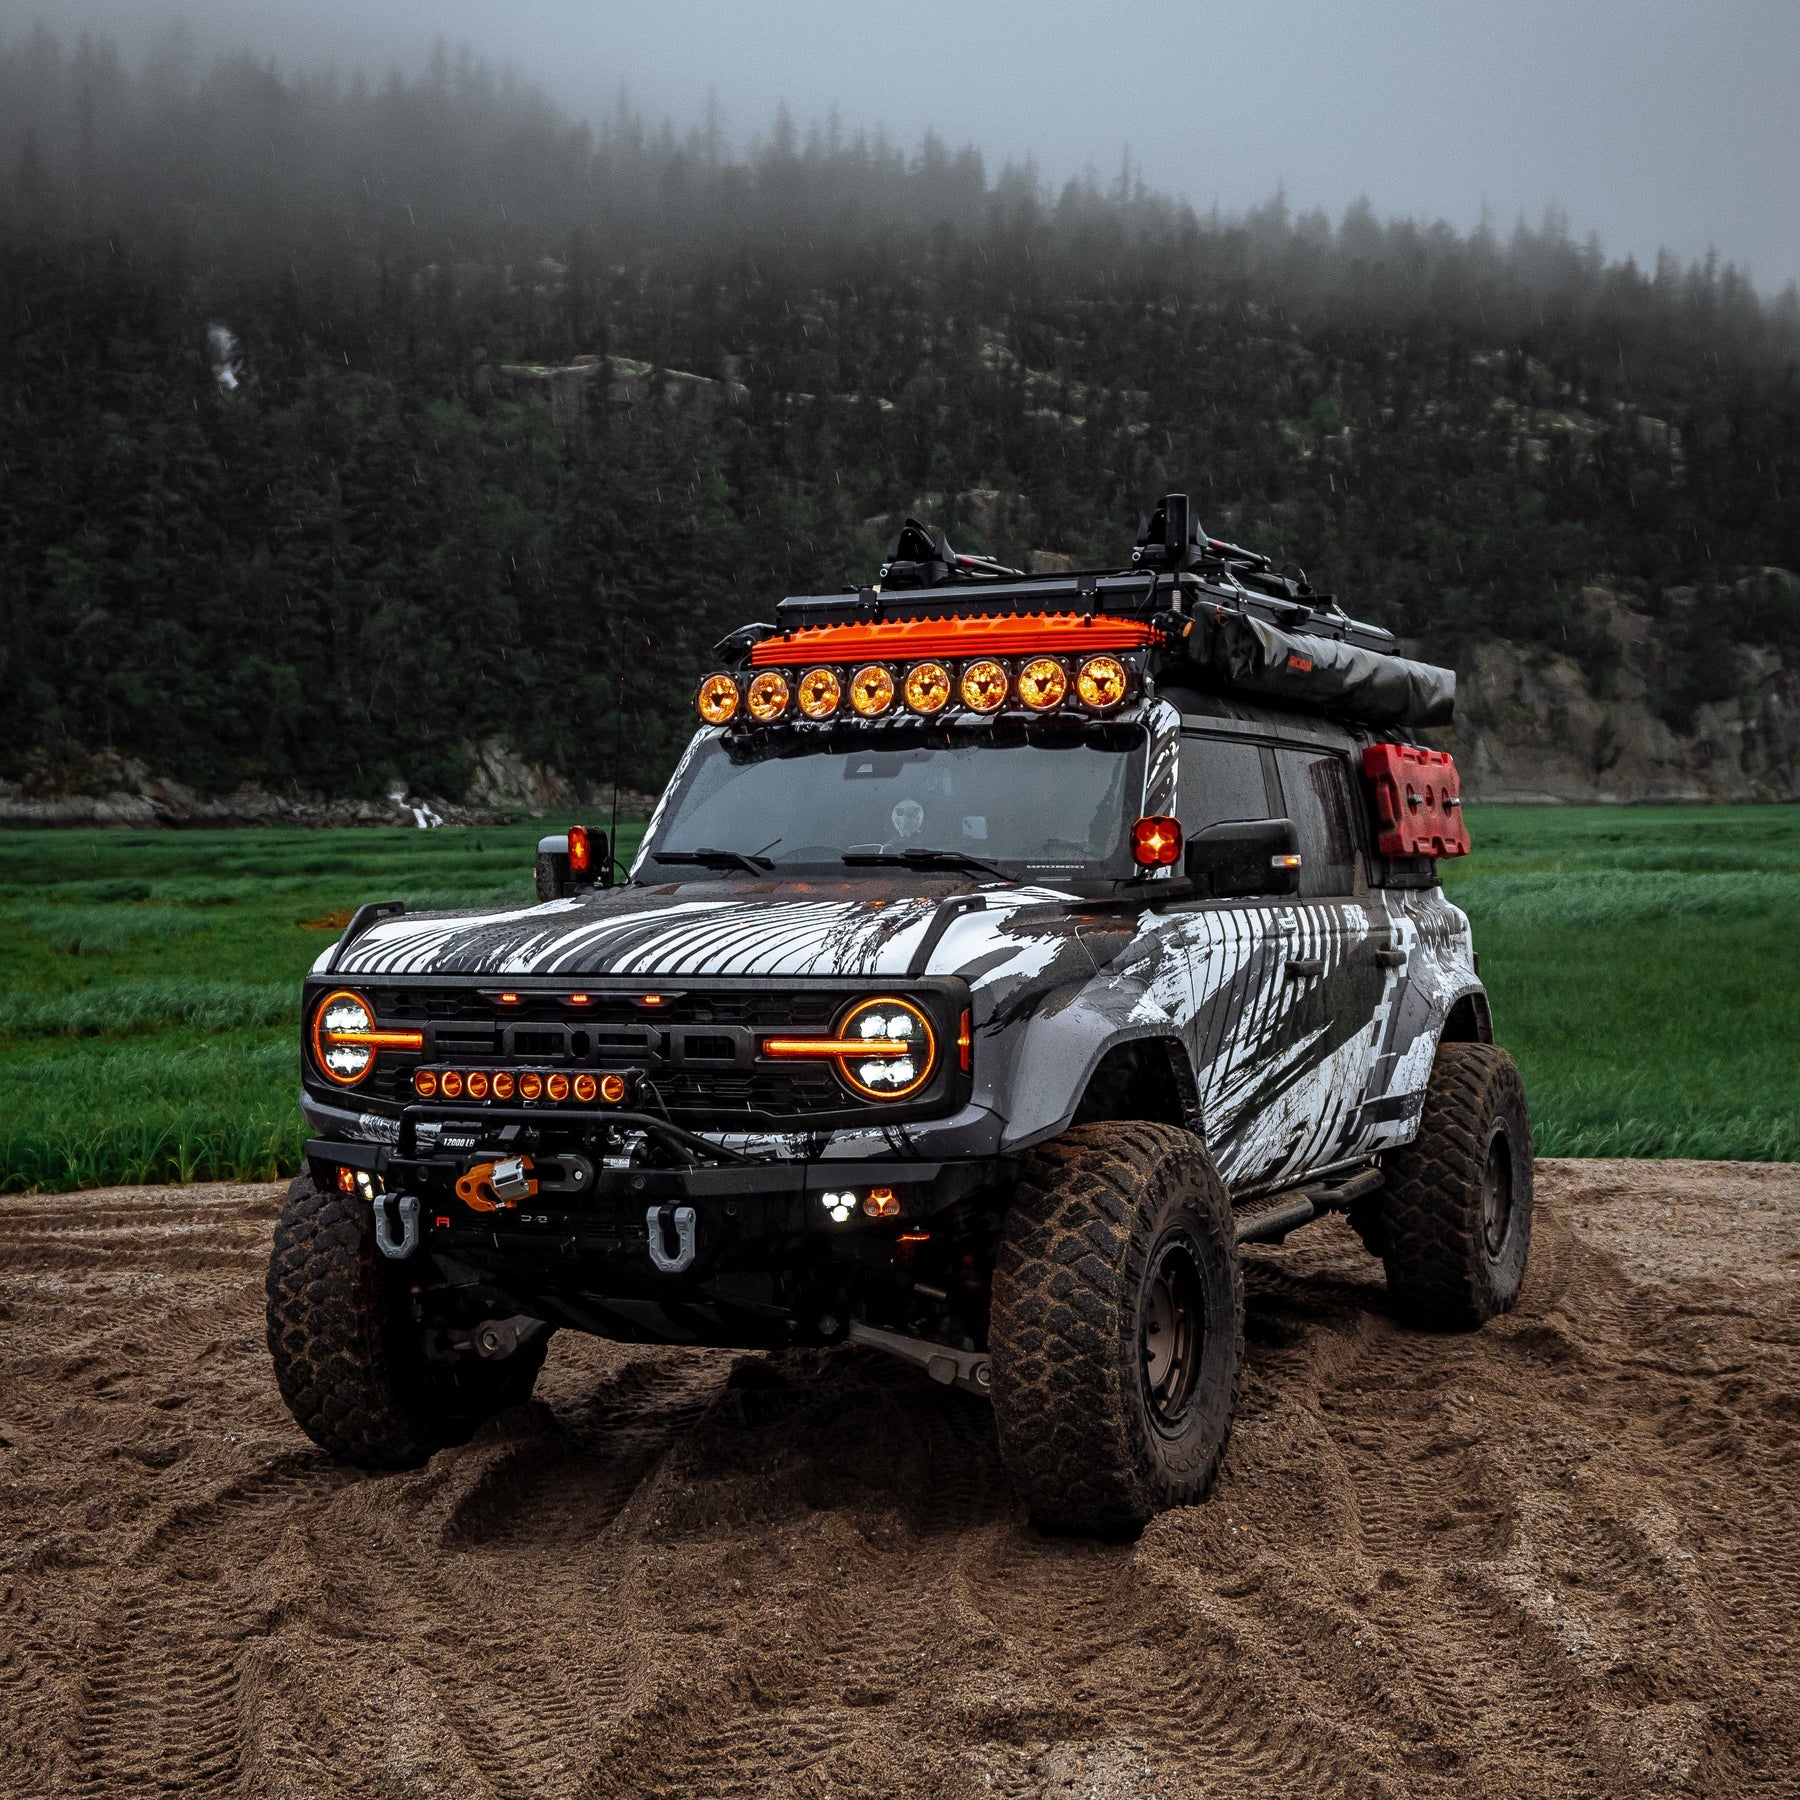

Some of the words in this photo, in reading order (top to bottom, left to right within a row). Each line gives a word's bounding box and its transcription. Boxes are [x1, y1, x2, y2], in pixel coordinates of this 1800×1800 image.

[423, 1019, 756, 1067] FORD
[443, 1138, 465, 1147] 12000
[465, 1138, 475, 1147] LB
